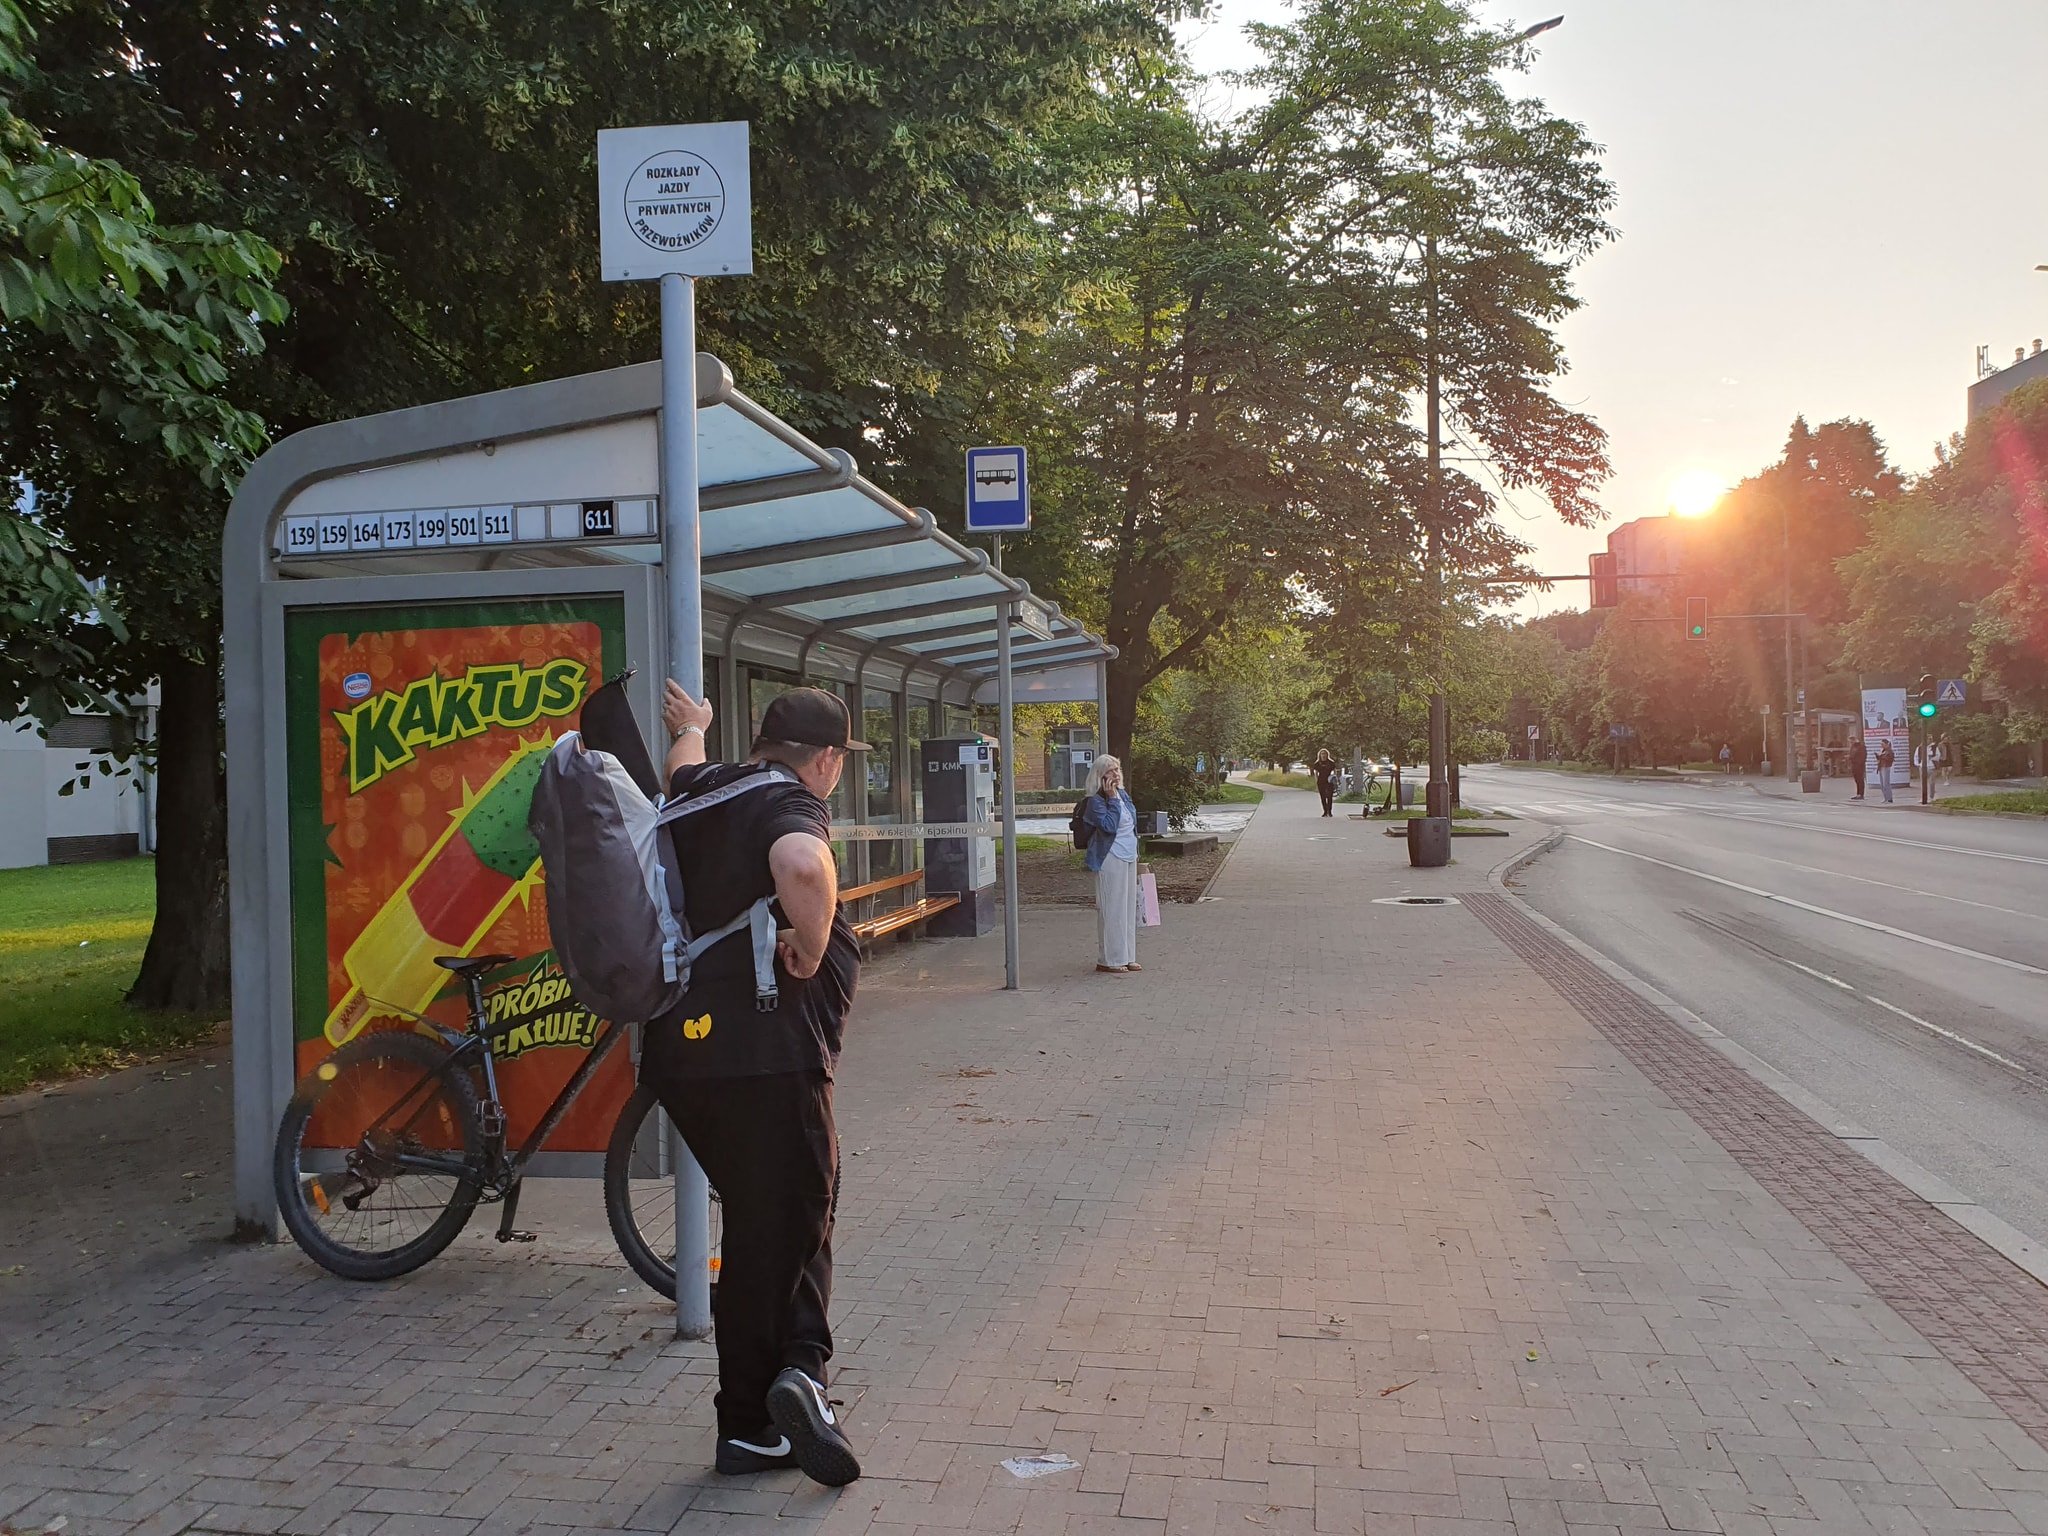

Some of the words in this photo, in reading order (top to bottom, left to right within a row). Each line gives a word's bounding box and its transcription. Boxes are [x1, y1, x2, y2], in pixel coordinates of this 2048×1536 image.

[646, 166, 700, 179] ROZKŁADY
[657, 182, 690, 194] JAZDY
[638, 202, 711, 216] PRYWATNYCH
[634, 214, 715, 248] PRZEWOŹNIKÓW
[290, 526, 315, 546] 139
[321, 525, 347, 544] 159
[353, 522, 380, 542] 164
[386, 521, 411, 540] 173
[418, 519, 445, 538] 199
[450, 517, 477, 536] 501
[484, 515, 510, 535] 511
[584, 510, 612, 530] 611
[345, 661, 583, 789] KAKTUS
[942, 762, 963, 770] KMK
